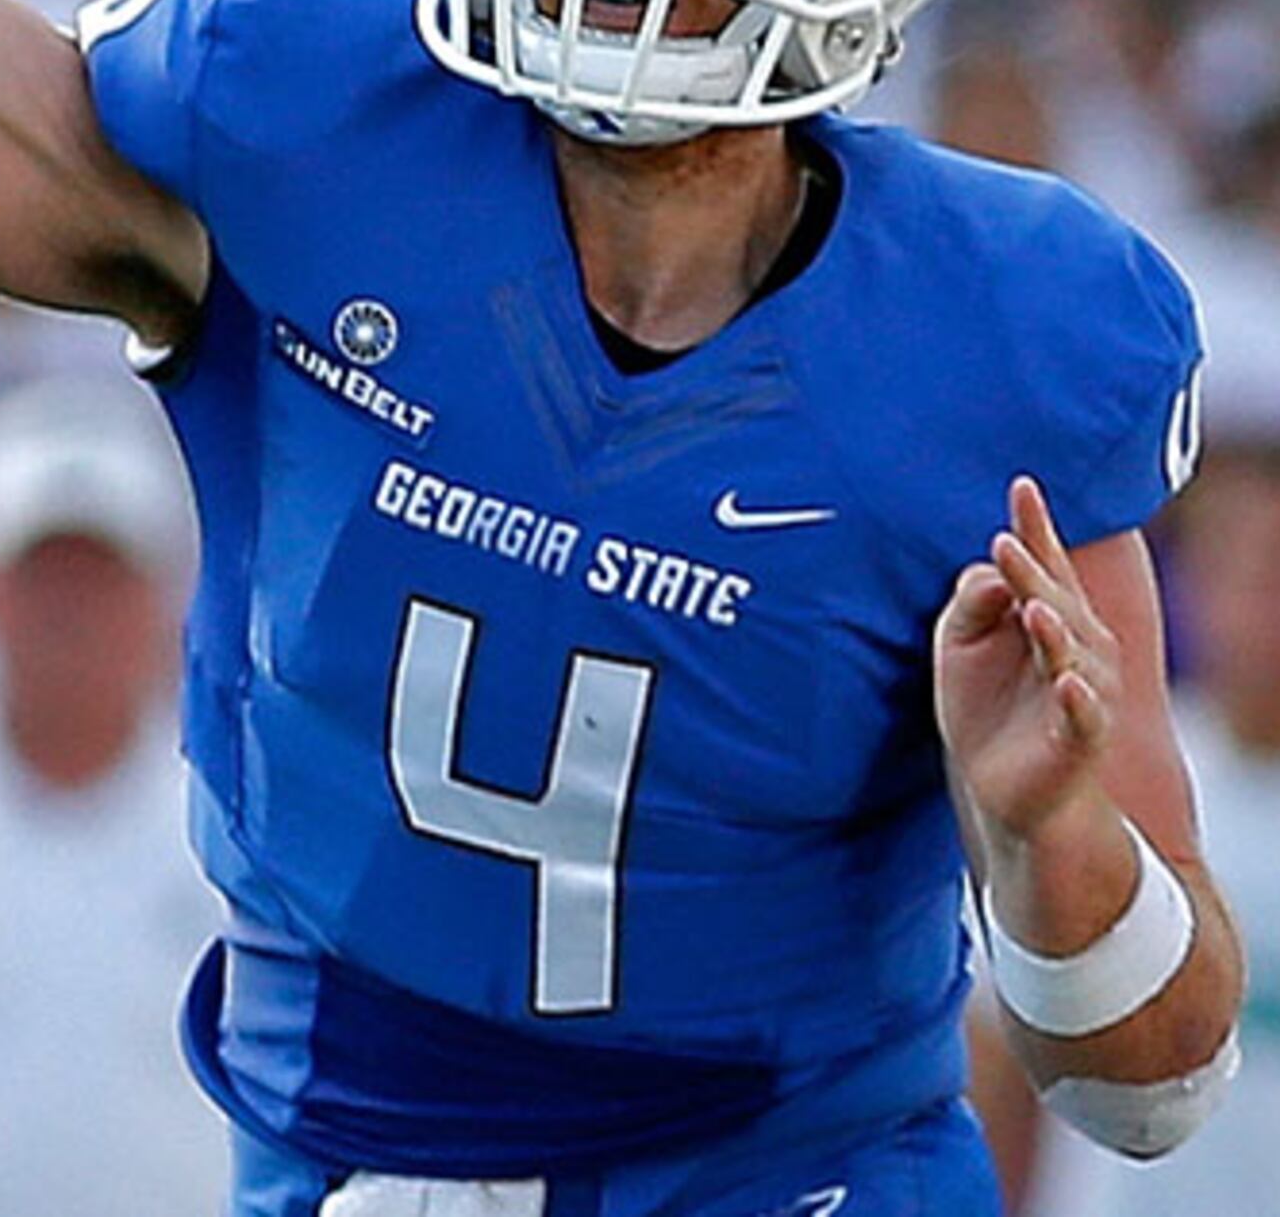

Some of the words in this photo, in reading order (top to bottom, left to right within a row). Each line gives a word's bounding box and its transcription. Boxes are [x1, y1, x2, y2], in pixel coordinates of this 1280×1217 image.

[341, 367, 435, 436] BELT
[375, 462, 580, 575] GEORGIA
[586, 537, 752, 627] STATE
[386, 596, 656, 1016] 4
